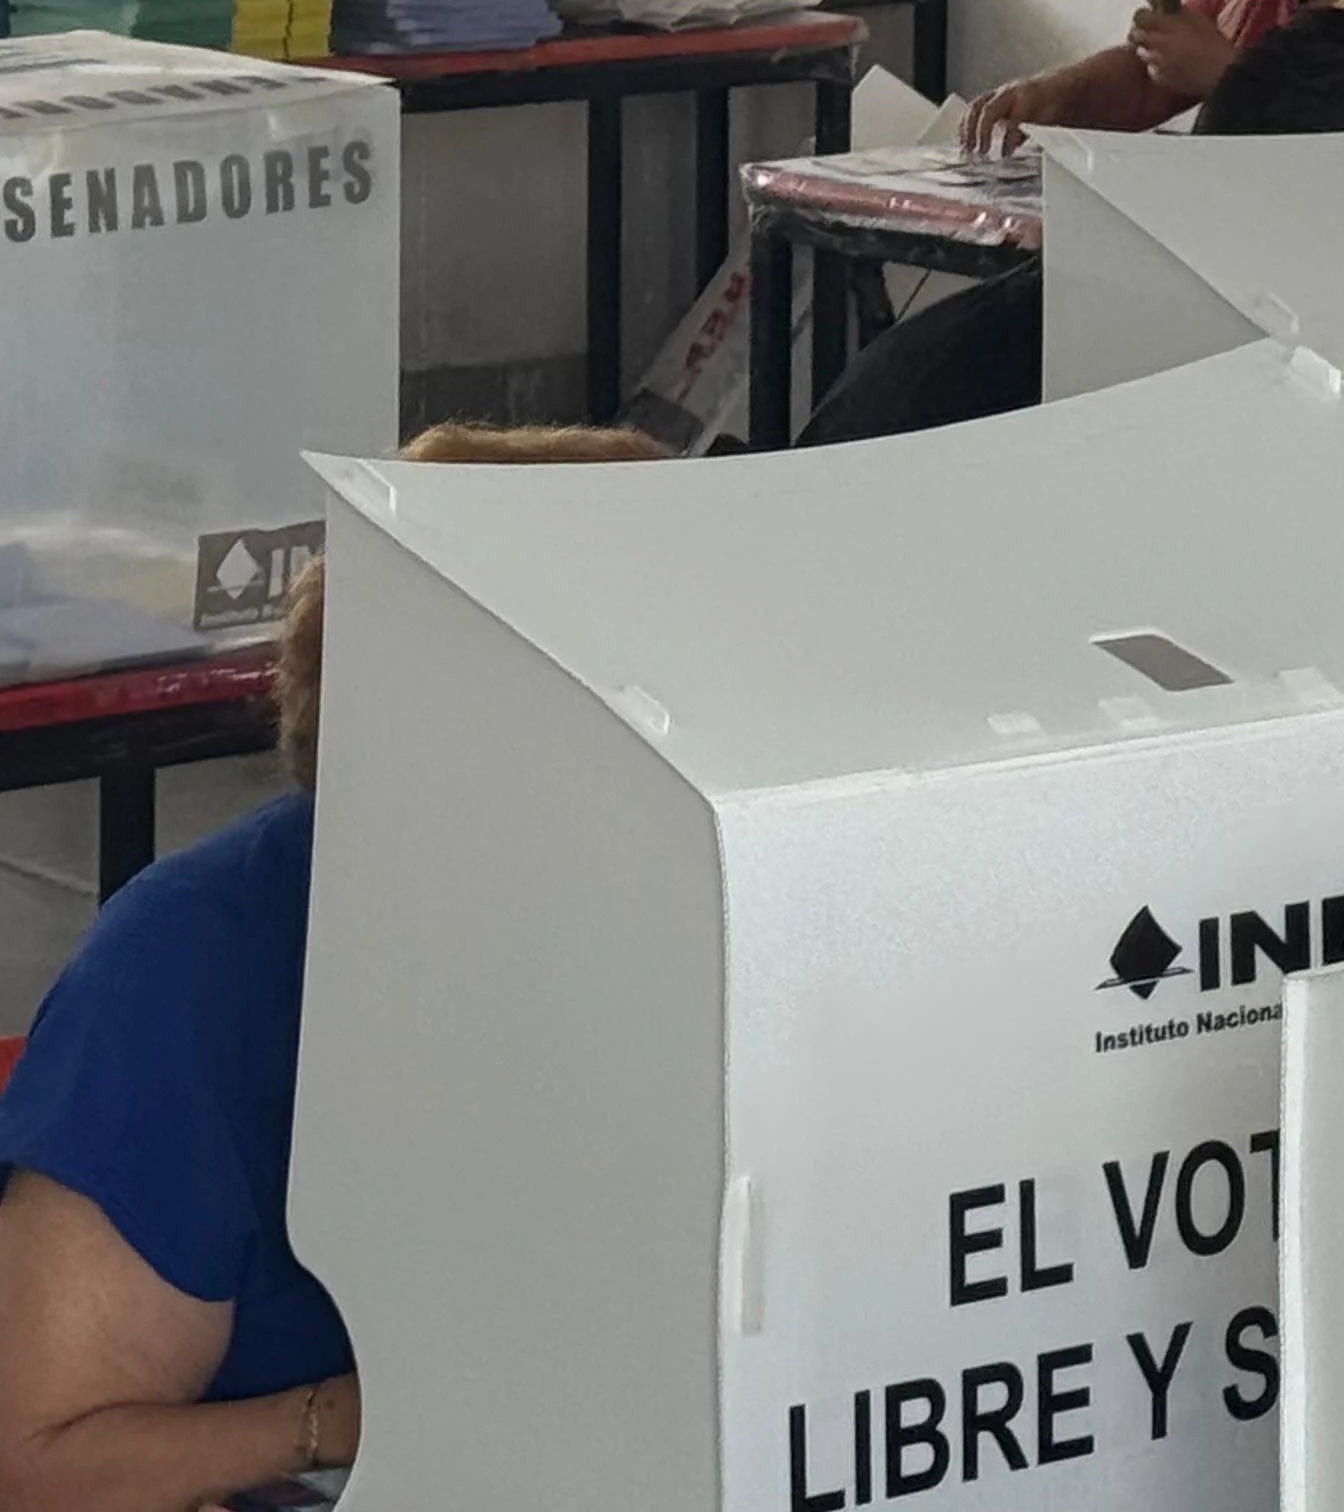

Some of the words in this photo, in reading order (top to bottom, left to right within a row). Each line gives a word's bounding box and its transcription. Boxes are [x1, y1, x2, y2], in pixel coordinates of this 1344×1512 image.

[2, 139, 372, 243] SENADORES
[1095, 1017, 1190, 1053] Instituto
[949, 1177, 1075, 1307] EL
[789, 1343, 1094, 1512] LIBRE
[1125, 1321, 1194, 1442] Y
